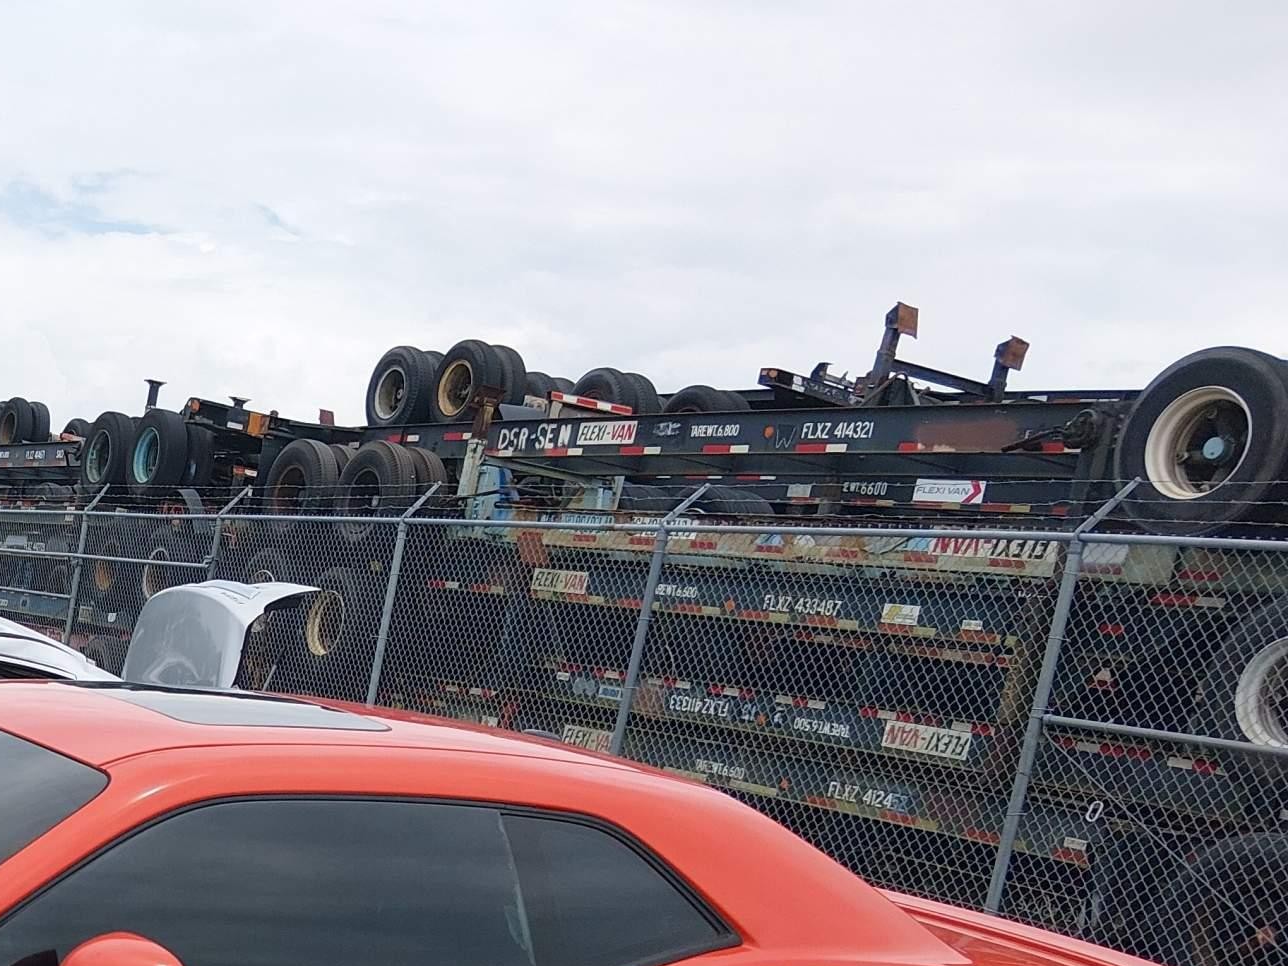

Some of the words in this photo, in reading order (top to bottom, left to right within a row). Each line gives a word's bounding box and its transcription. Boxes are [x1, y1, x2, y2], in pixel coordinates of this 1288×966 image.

[578, 423, 635, 443] FLEXI-VAN
[801, 422, 829, 439] FLXZ
[834, 421, 874, 439] 414321
[916, 486, 948, 495] FLEXI
[951, 486, 970, 496] VAN
[533, 570, 585, 591] FLEXI-VAN
[763, 594, 792, 612] FLXZ
[828, 782, 859, 802] FLXZ
